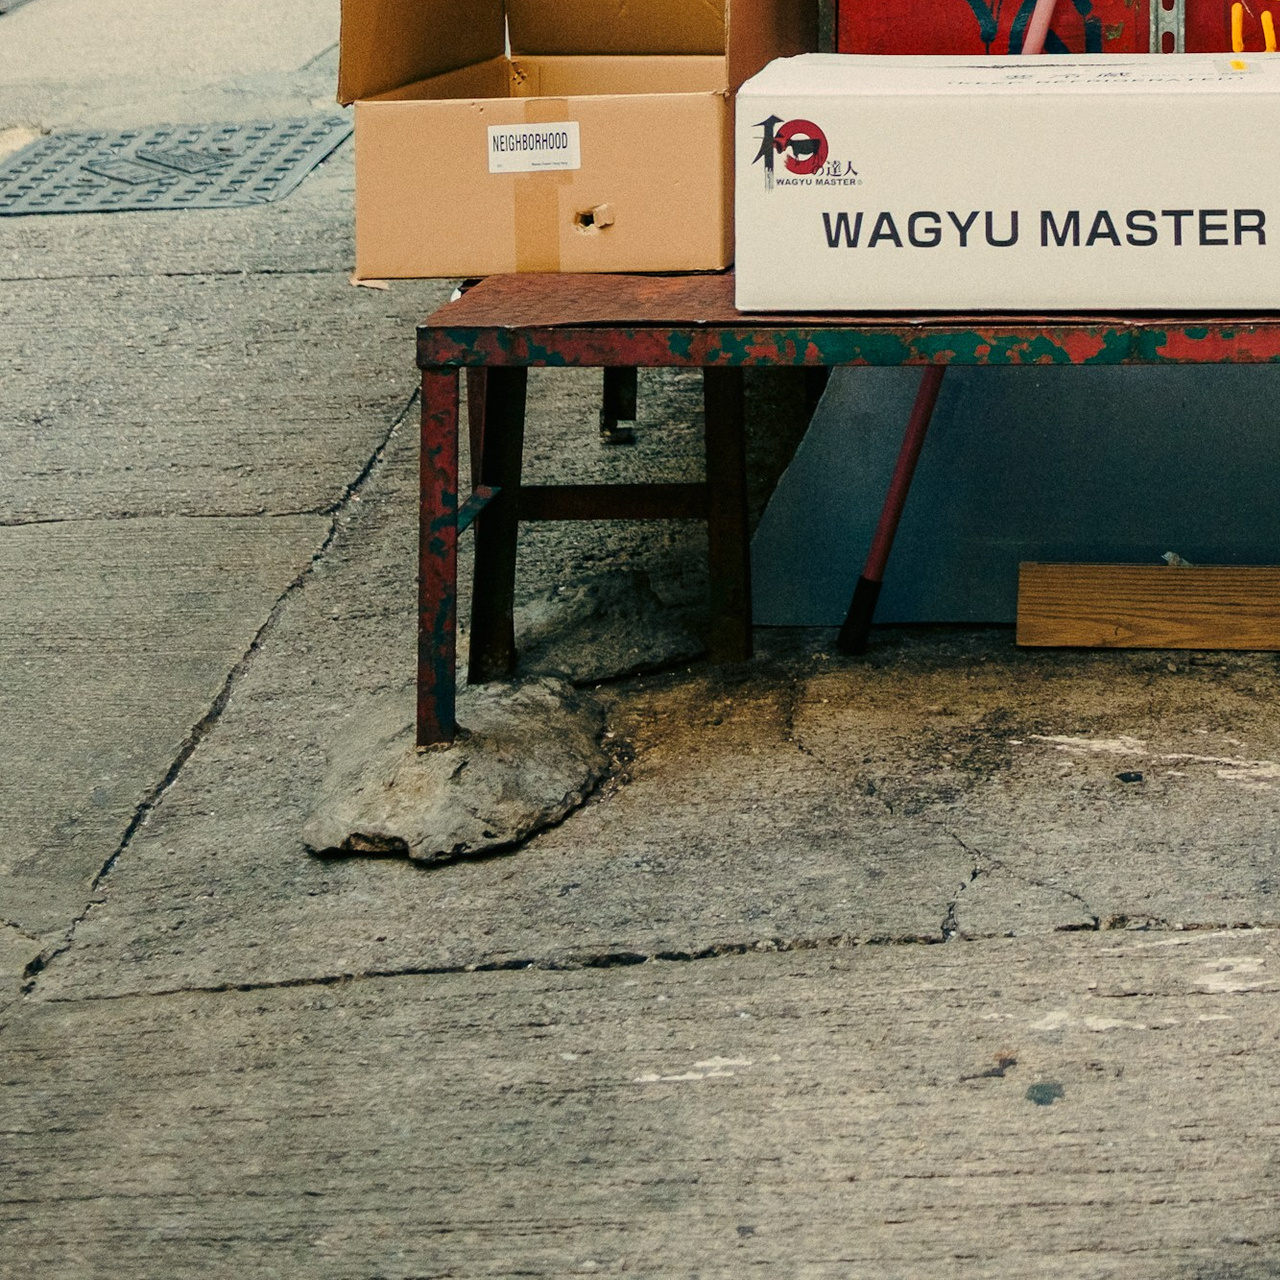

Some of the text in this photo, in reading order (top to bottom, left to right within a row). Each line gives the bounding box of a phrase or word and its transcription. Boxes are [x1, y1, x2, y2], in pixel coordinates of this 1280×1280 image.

[492, 132, 568, 152] NEIGHBORHOOD
[776, 178, 812, 186] WAGYU
[822, 208, 1268, 249] WAGYU MASTER
